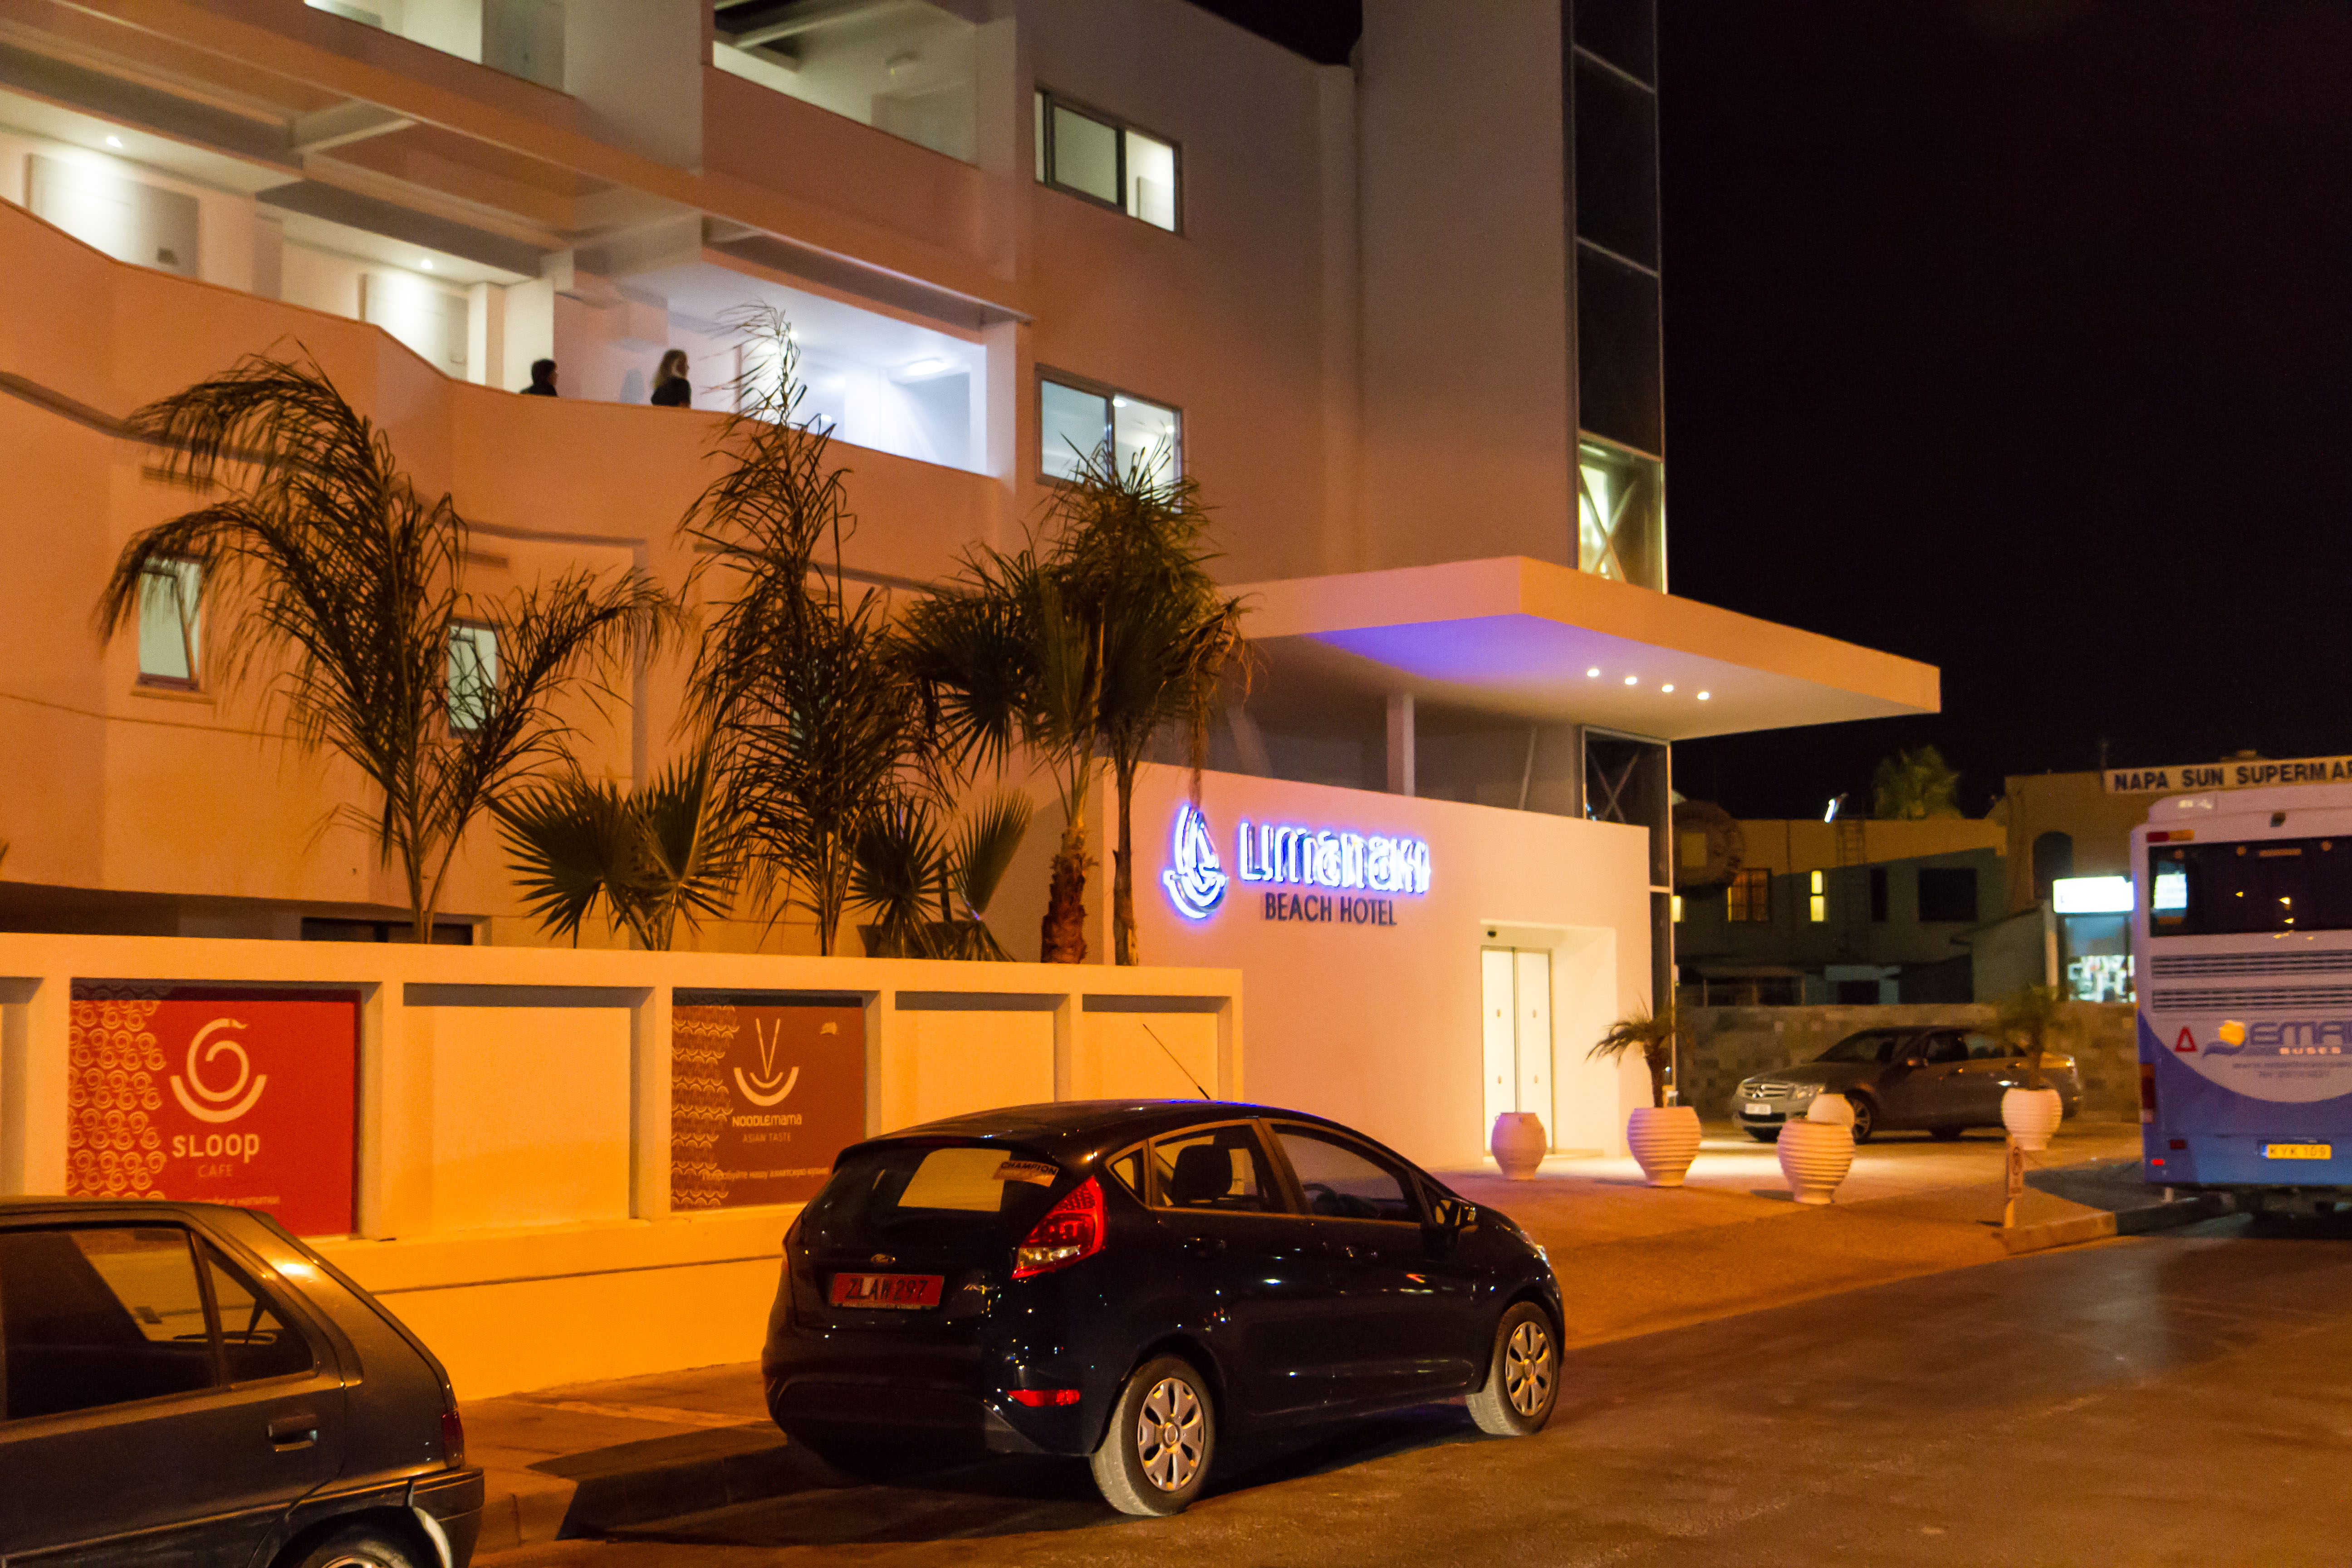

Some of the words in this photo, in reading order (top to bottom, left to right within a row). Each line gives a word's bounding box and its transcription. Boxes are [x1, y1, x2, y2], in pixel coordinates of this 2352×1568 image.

[2114, 771, 2170, 792] NAPA
[2181, 768, 2223, 788] SUN
[1264, 892, 1332, 921] BEACH
[1340, 896, 1397, 926] HOTEL
[743, 1132, 766, 1143] ASIAN
[769, 1132, 791, 1142] TASTE
[197, 1163, 233, 1178] CAFE
[1000, 1161, 1058, 1175] CHAMPION
